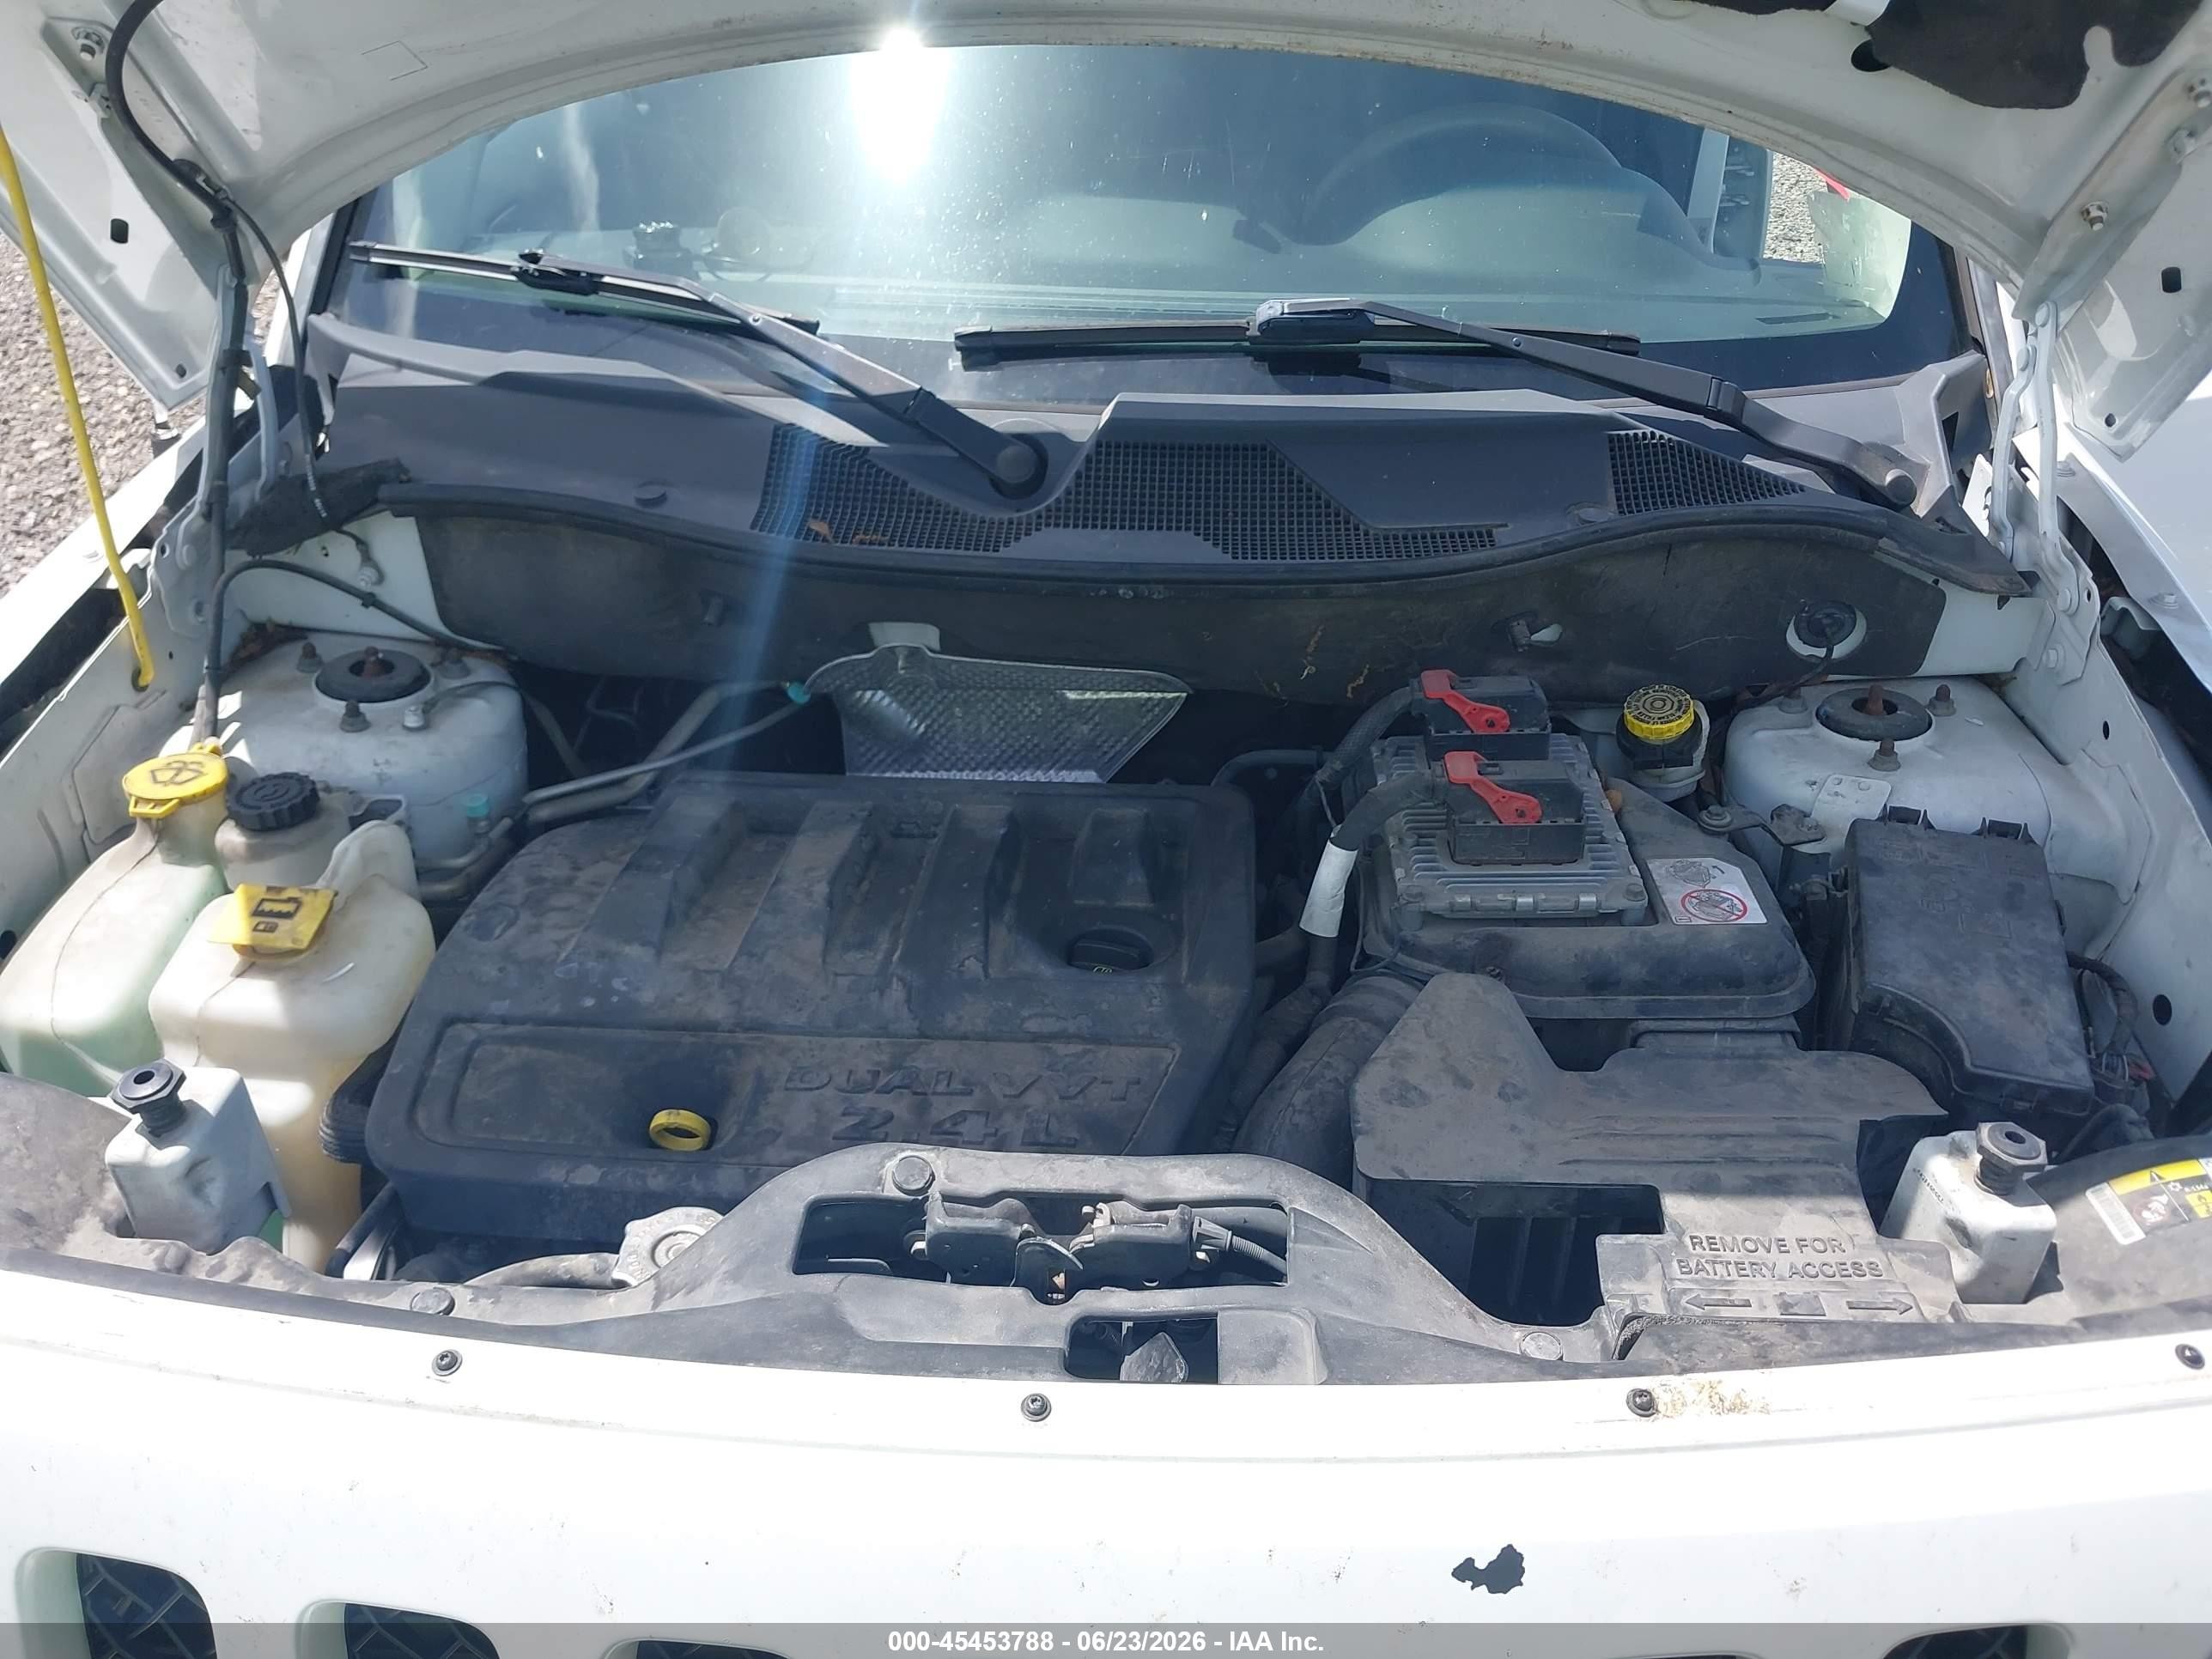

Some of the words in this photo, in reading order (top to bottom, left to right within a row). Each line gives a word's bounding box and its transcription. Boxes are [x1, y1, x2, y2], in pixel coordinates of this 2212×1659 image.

[783, 1066, 974, 1097] DUAL
[992, 1071, 1140, 1102] VVT
[1688, 1234, 1790, 1254] REMOVE
[1797, 1236, 1847, 1255] FOR
[1675, 1257, 1778, 1278] BATTERY
[1788, 1260, 1884, 1279] ACCESS
